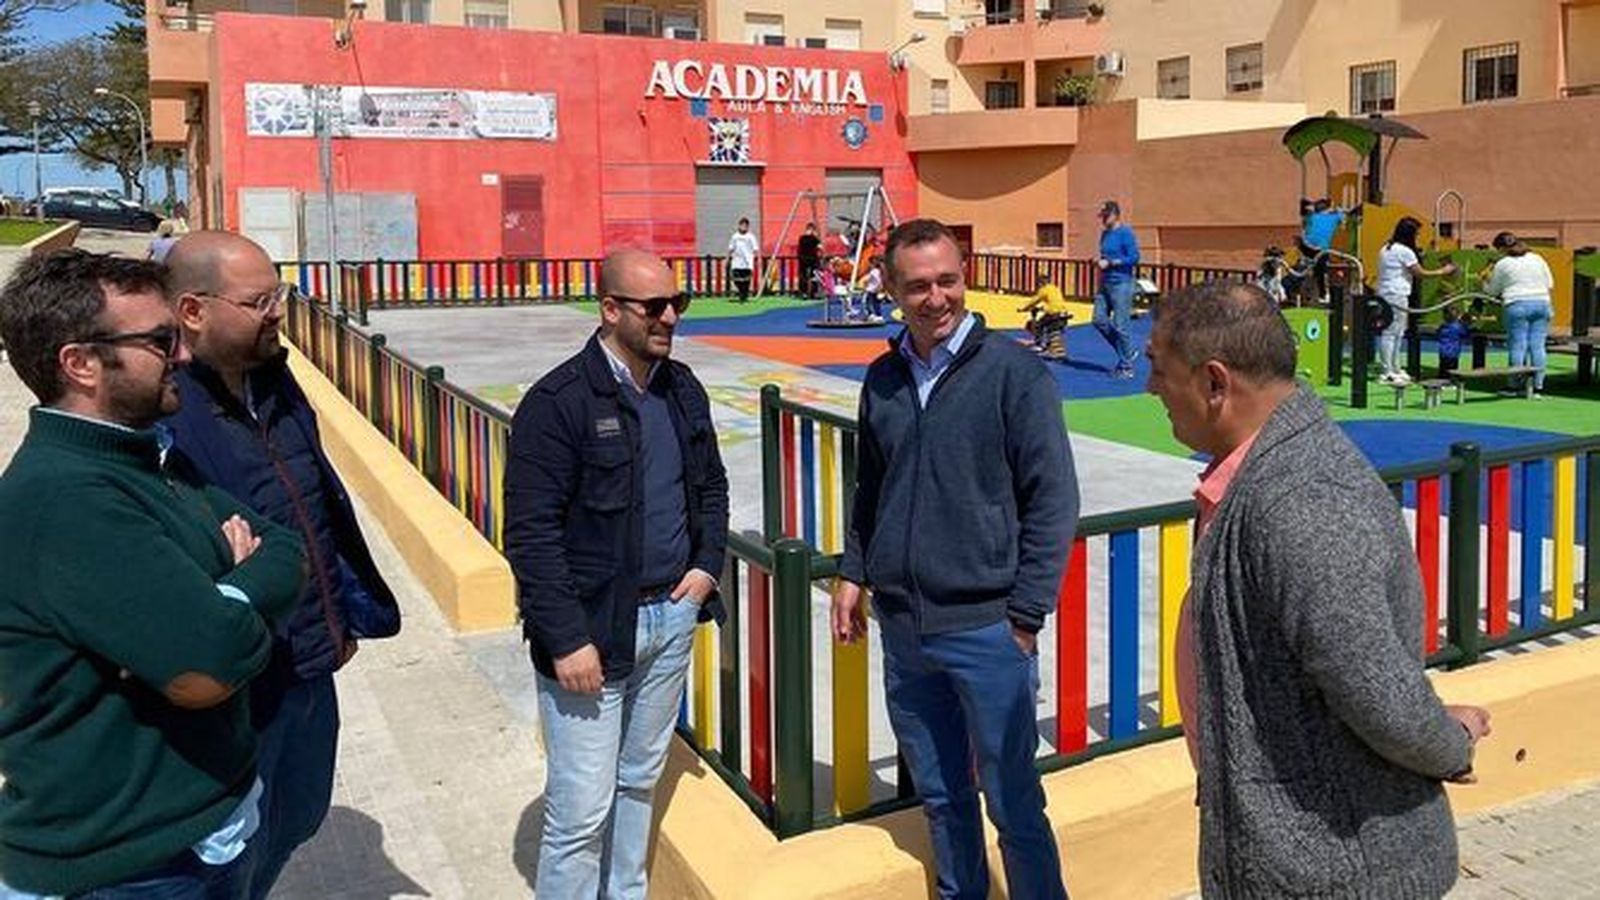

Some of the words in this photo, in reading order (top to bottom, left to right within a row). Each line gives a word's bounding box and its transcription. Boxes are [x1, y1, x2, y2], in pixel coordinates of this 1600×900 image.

[645, 58, 867, 105] ACADEMIA
[726, 100, 766, 113] AULA
[774, 103, 784, 113] &
[790, 102, 847, 115] ENGLISH
